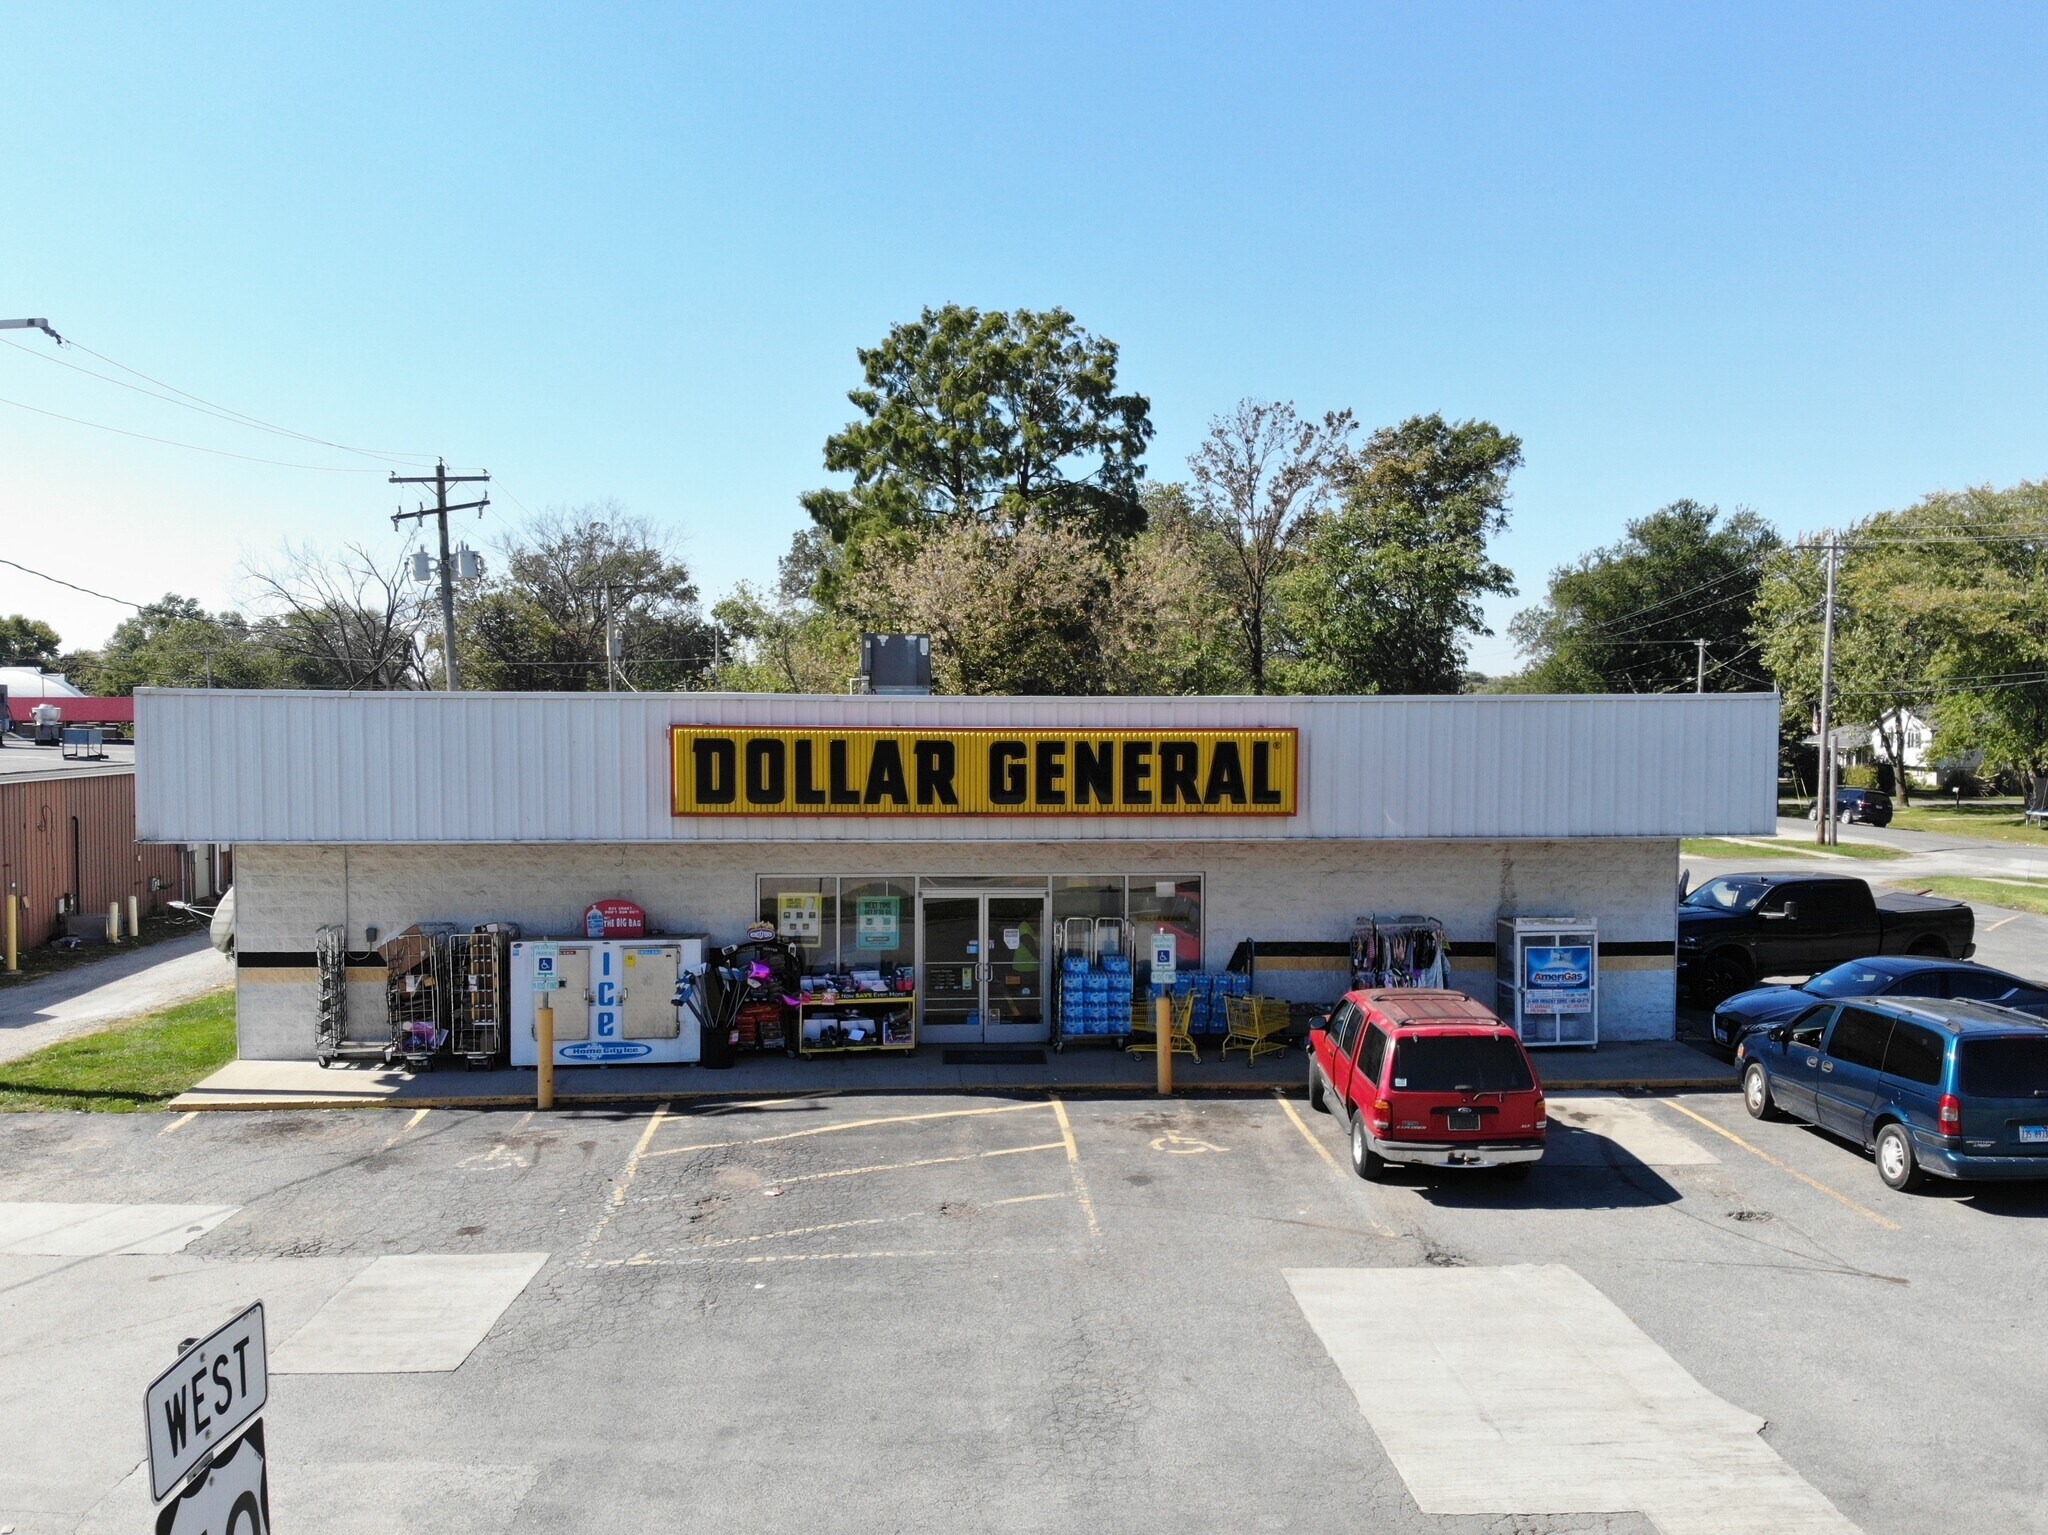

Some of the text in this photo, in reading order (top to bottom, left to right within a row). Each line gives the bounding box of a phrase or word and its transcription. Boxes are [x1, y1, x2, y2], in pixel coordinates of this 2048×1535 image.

[691, 738, 1281, 805] DOLLAR GENERAL
[604, 918, 642, 927] THE BIG BAG
[1534, 972, 1582, 981] AmeriGas
[164, 1336, 250, 1458] WEST
